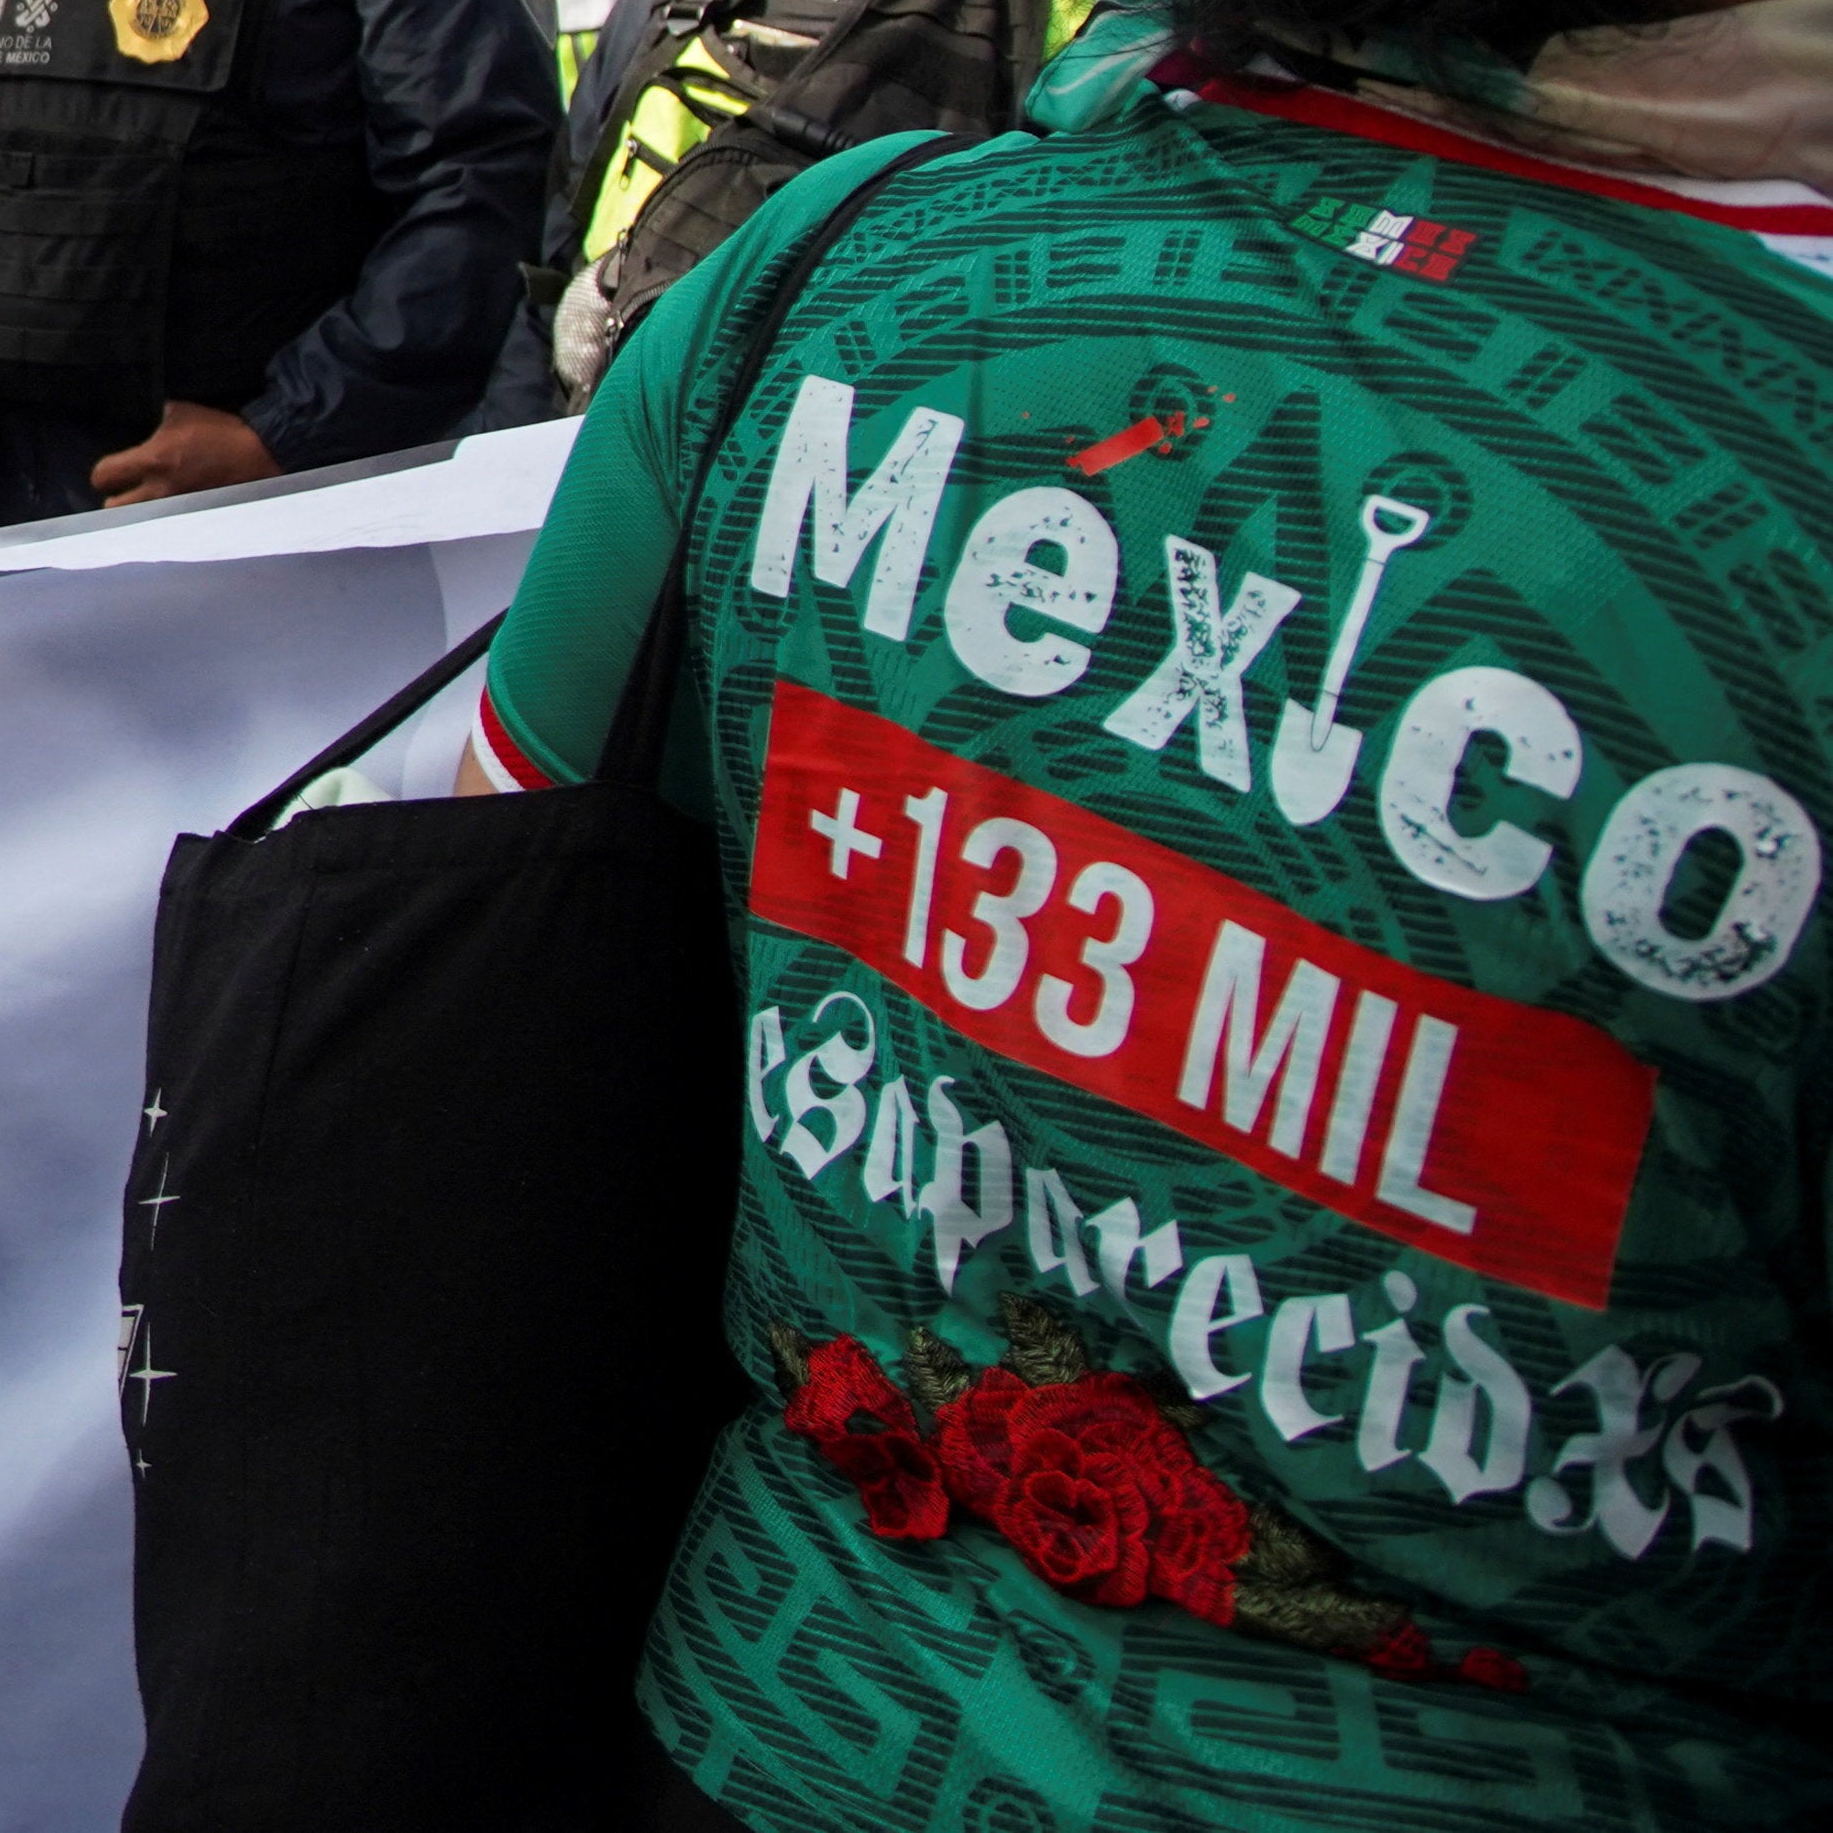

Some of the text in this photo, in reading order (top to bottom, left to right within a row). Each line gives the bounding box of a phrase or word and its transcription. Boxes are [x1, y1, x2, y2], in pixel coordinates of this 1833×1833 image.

[15, 35, 32, 49] DE
[35, 36, 52, 51] LA
[810, 787, 1478, 1235] +133 MIL
[748, 989, 1785, 1561] esaparecidxs
